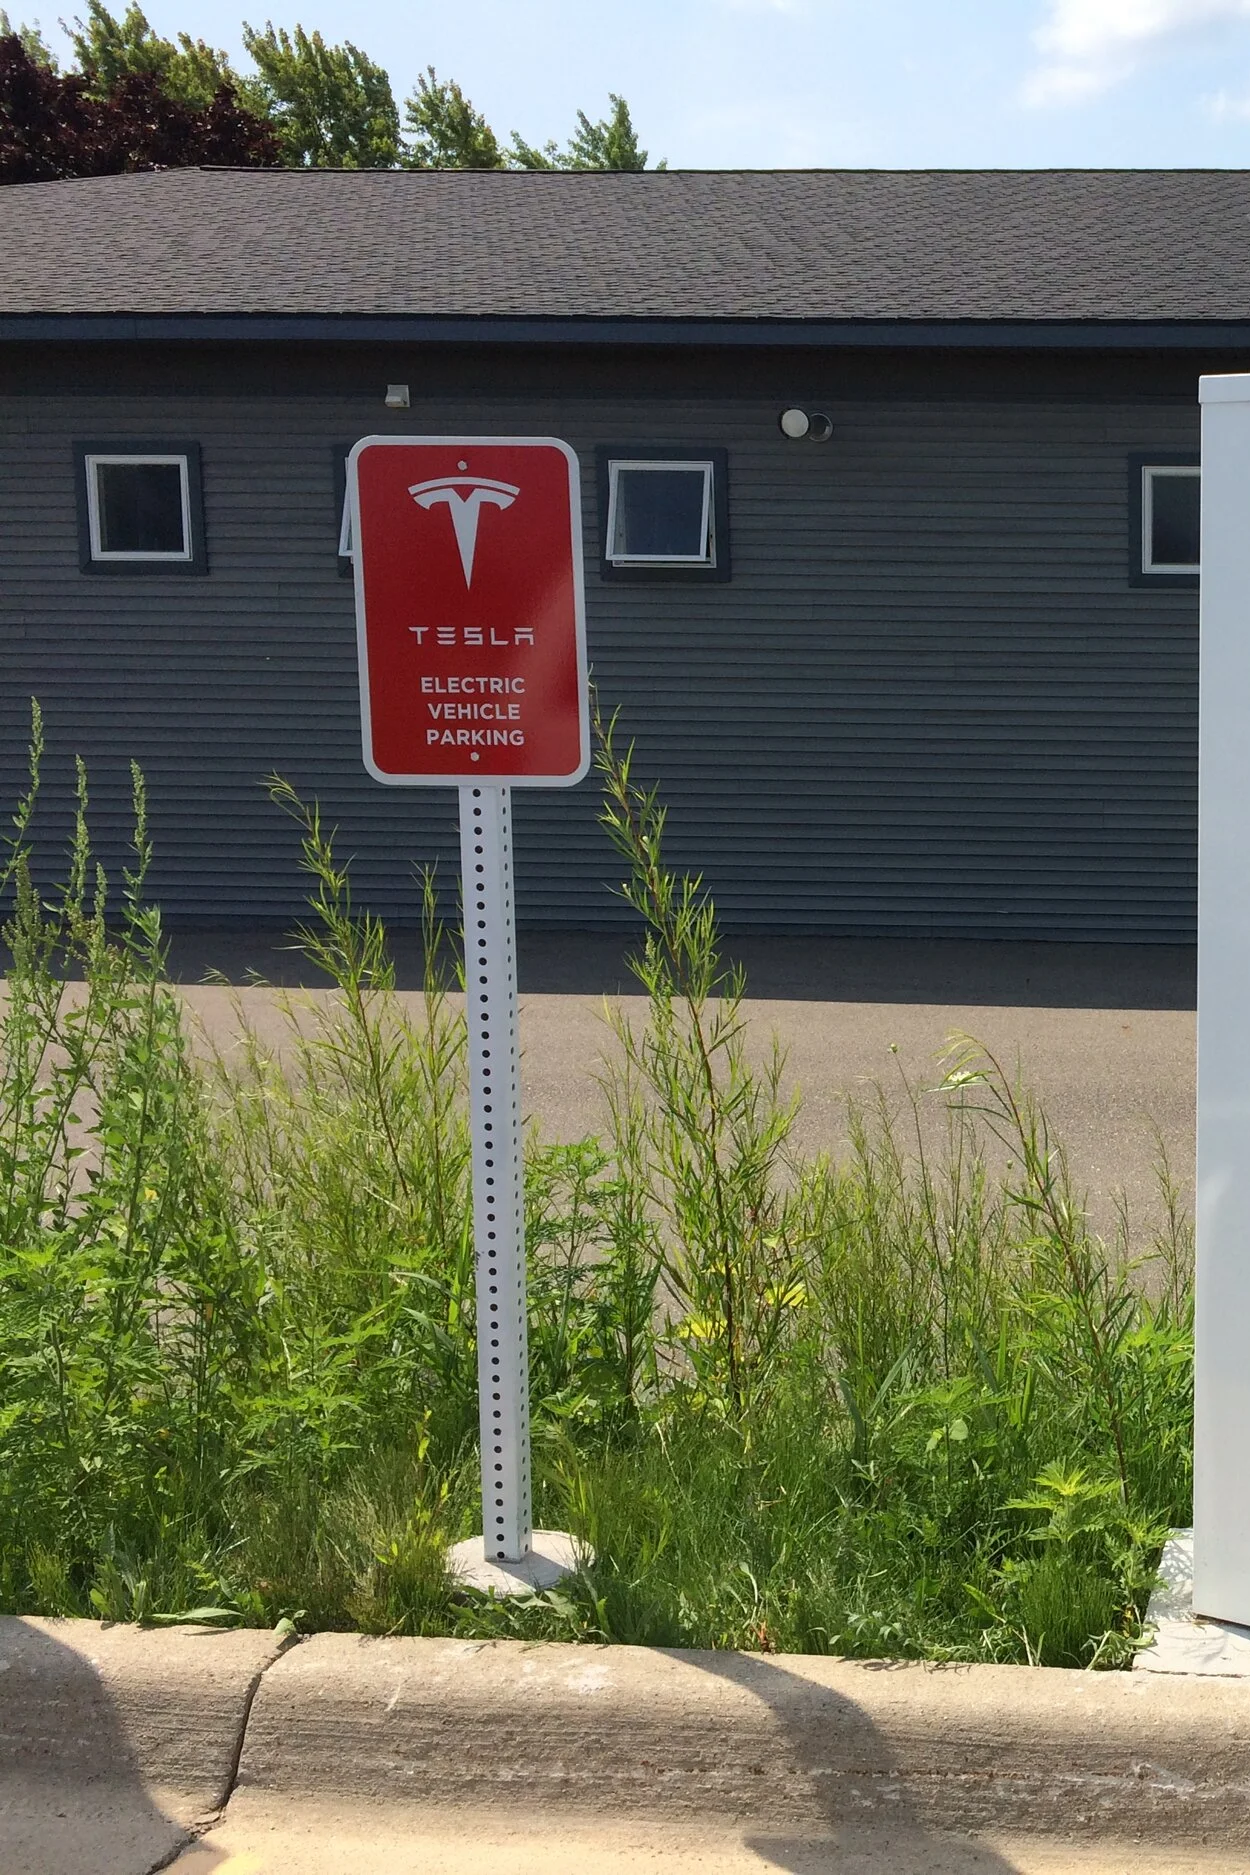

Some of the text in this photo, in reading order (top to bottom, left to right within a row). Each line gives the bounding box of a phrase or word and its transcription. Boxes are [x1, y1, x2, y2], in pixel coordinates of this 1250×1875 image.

[408, 626, 535, 646] TESLA
[420, 676, 526, 695] ELECTRIC
[427, 702, 521, 720] VEHICLE
[426, 729, 525, 746] PARKING
